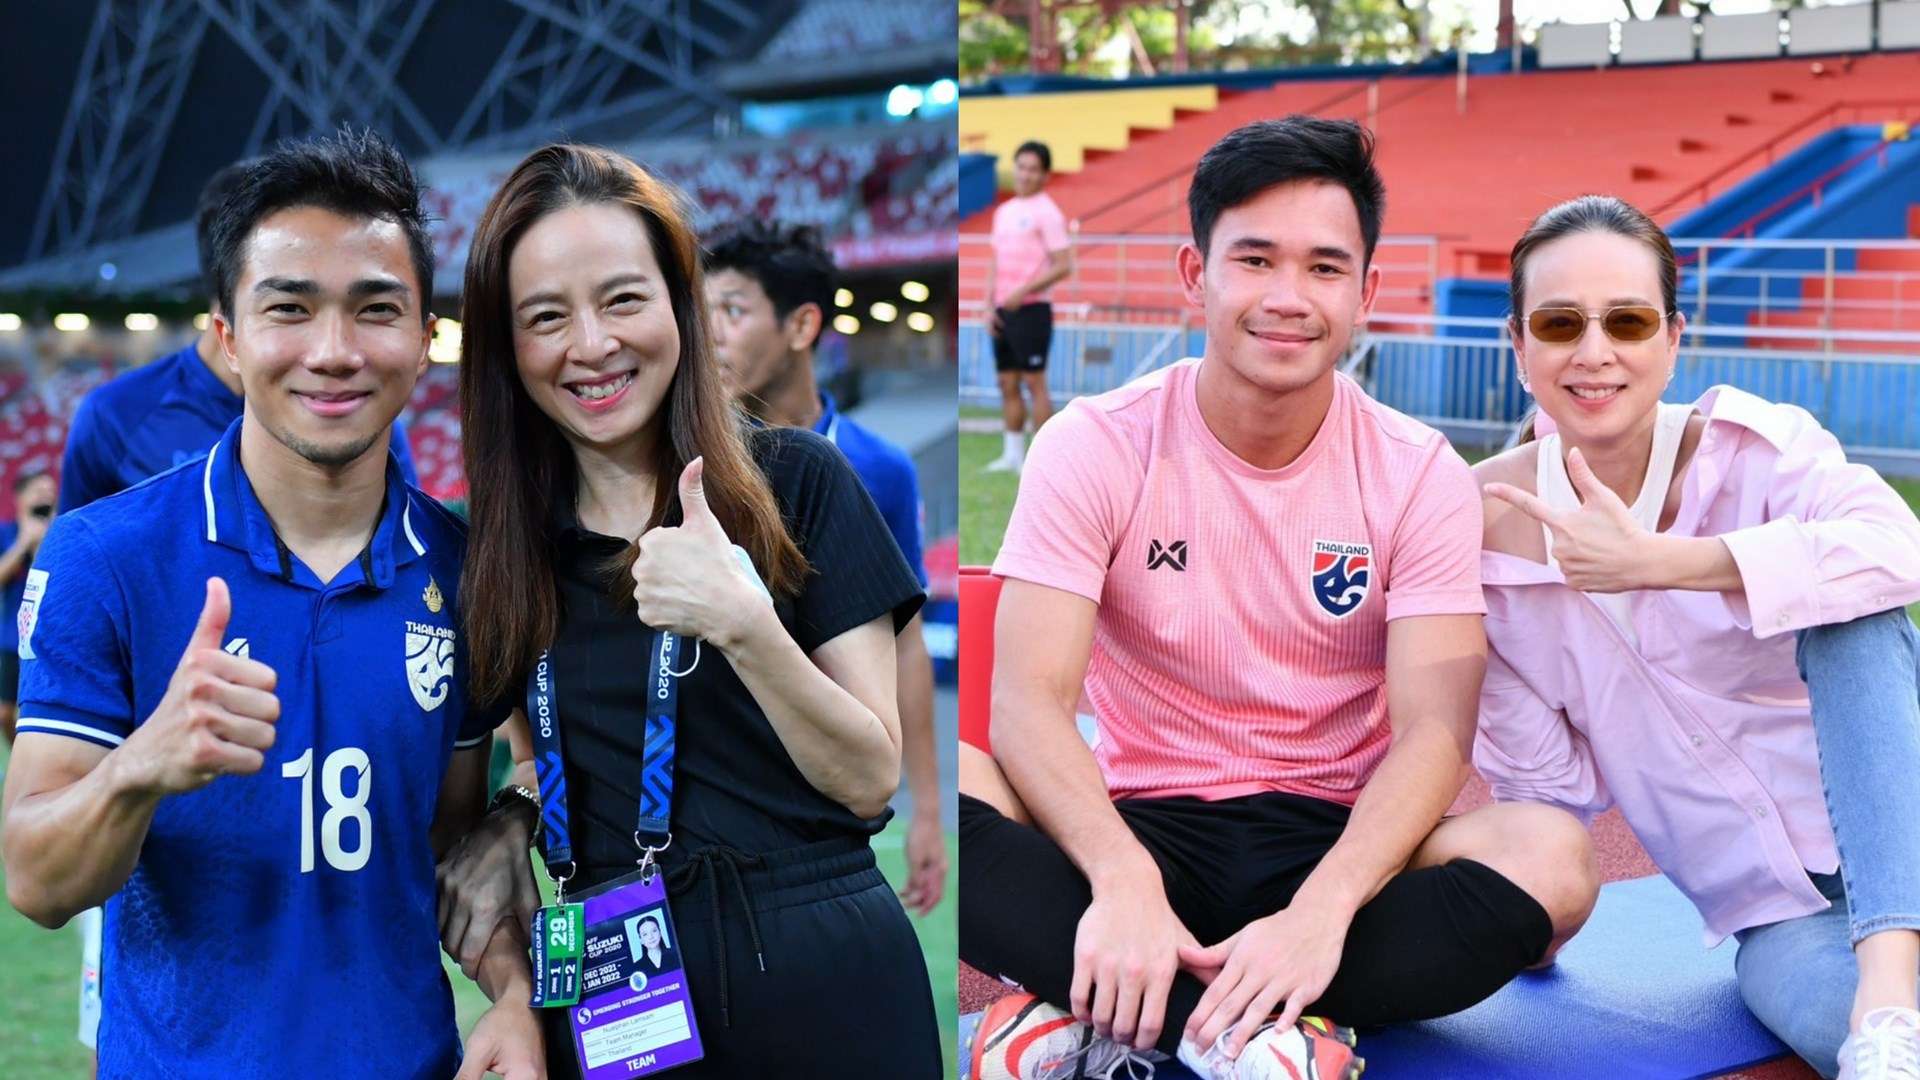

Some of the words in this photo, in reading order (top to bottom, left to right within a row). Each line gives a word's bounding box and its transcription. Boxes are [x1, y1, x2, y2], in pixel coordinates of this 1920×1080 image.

[1316, 542, 1369, 555] THAILAND
[405, 621, 456, 641] THAILAND
[536, 661, 548, 692] CUP
[658, 656, 670, 699] 2020
[537, 695, 552, 738] 2020
[281, 747, 372, 873] 18
[550, 918, 567, 947] 29
[587, 934, 624, 953] SUZUKI
[588, 949, 602, 959] CUP
[604, 943, 622, 954] 2020
[550, 966, 561, 975] 1
[565, 964, 576, 974] 2
[583, 969, 599, 981] DEC
[599, 964, 617, 976] 2021
[587, 978, 601, 989] JAN
[601, 971, 621, 984] 2022
[651, 982, 680, 998] TOGETHER
[626, 1053, 657, 1072] TEAM
